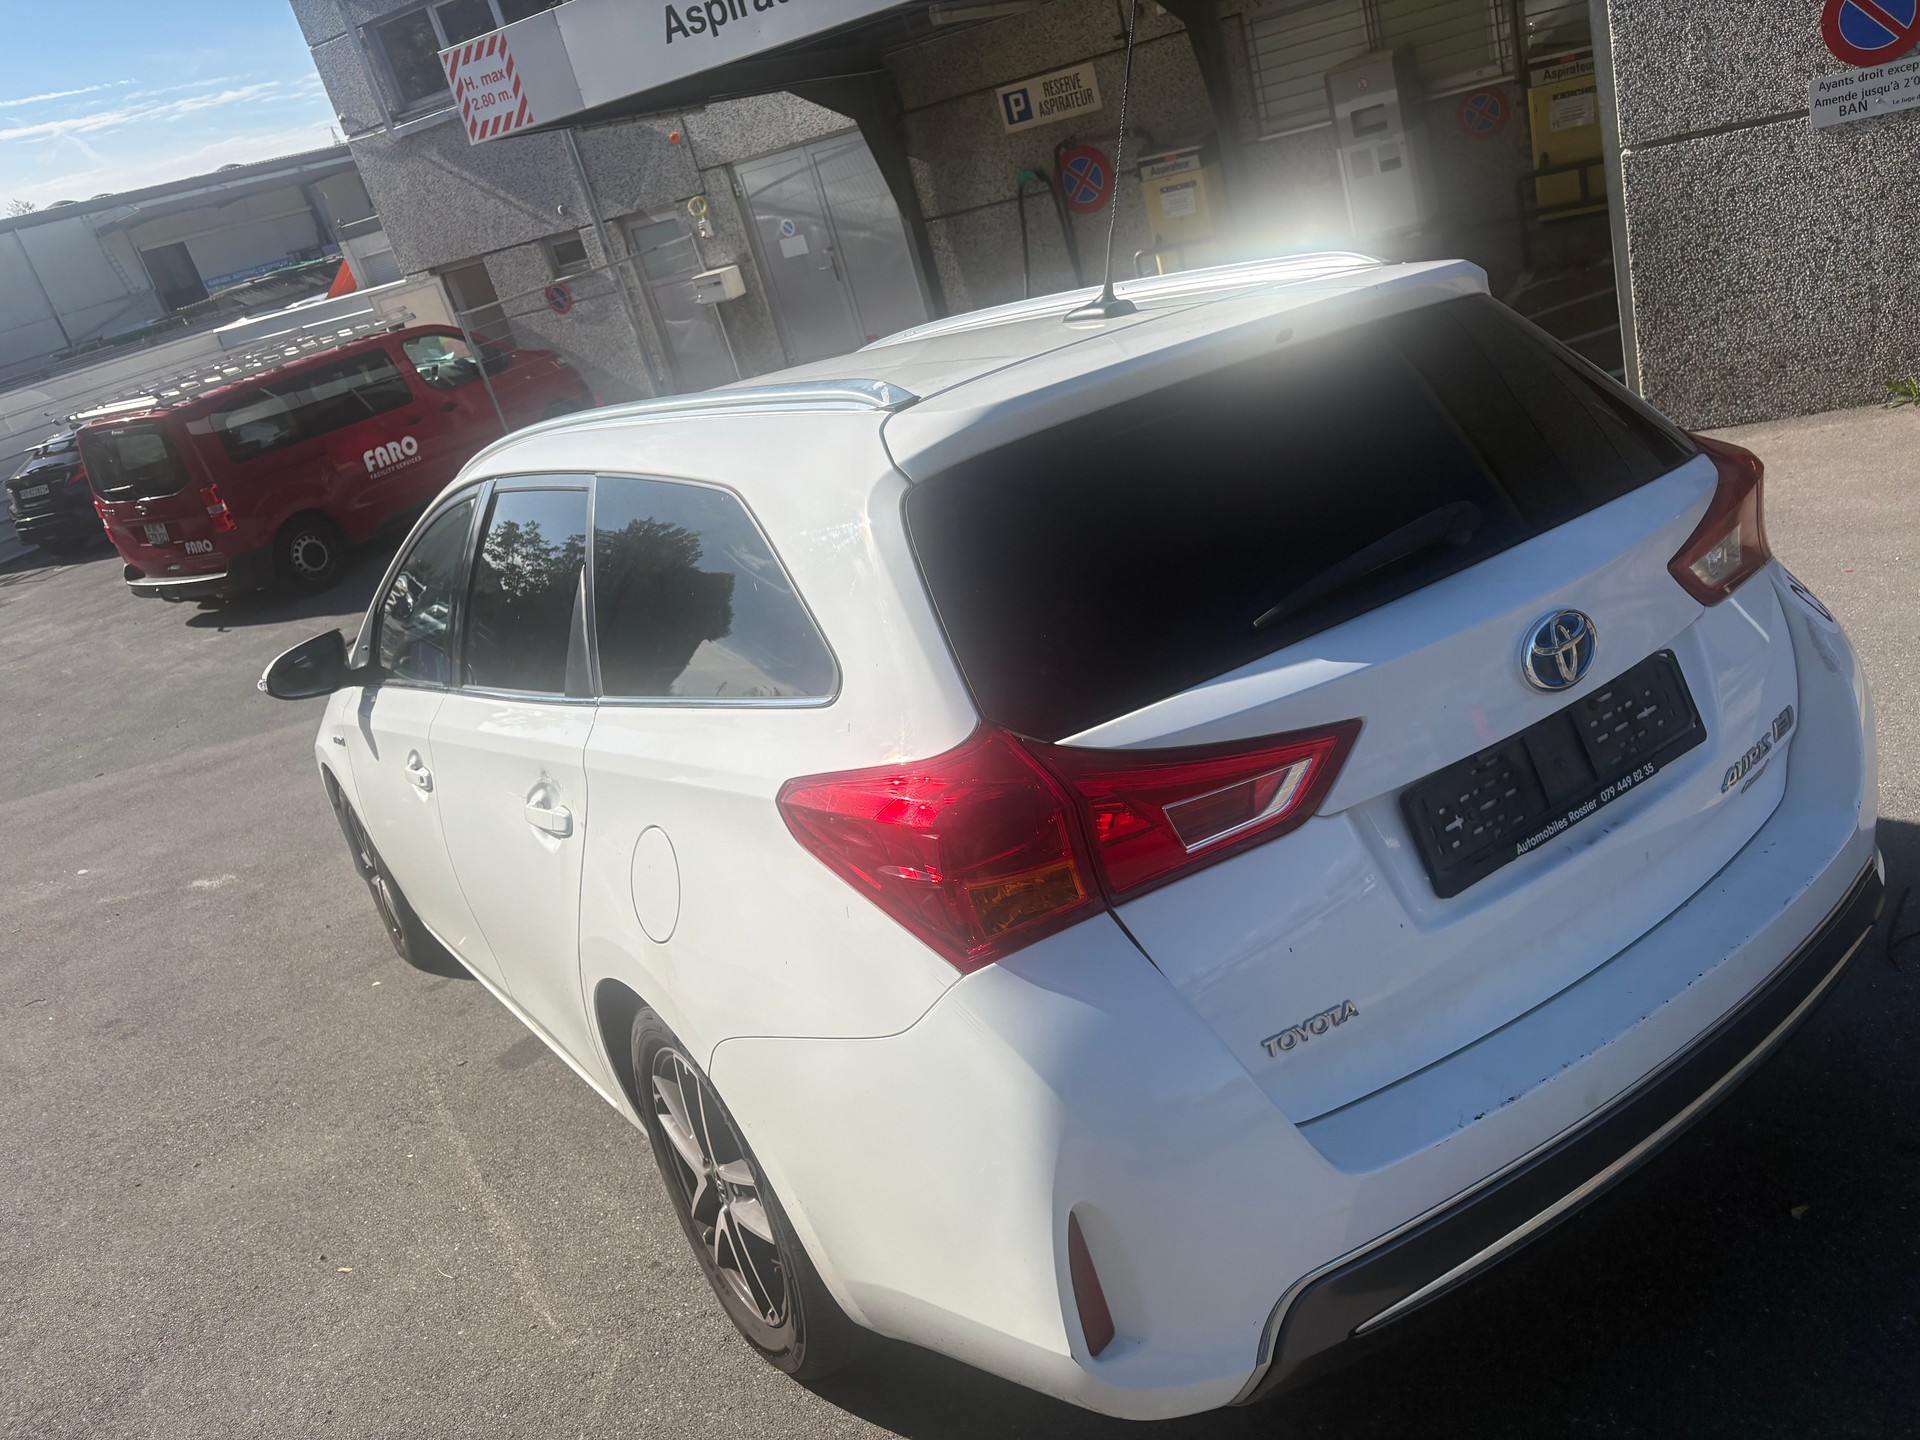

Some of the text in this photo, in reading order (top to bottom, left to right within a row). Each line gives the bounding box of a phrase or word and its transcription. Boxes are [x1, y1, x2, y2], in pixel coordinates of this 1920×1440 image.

[463, 68, 506, 92] H. max
[1042, 72, 1083, 98] RESERVE
[1818, 61, 1920, 93] Ayants droit excep
[471, 90, 513, 111] 2.80 m.
[1038, 88, 1095, 117] ASPIRATEUR
[1814, 91, 1858, 108] Amende
[1861, 80, 1900, 100] jusqu'à
[1839, 99, 1868, 117] BAN
[363, 435, 418, 473] FARO
[370, 455, 422, 480] FACILITY SERVICES
[184, 539, 213, 555] FARO
[1721, 732, 1773, 794] AURIS
[1516, 762, 1654, 855] Automobiles Rossier 079 449 82 35
[1260, 999, 1359, 1057] TOYOTA
